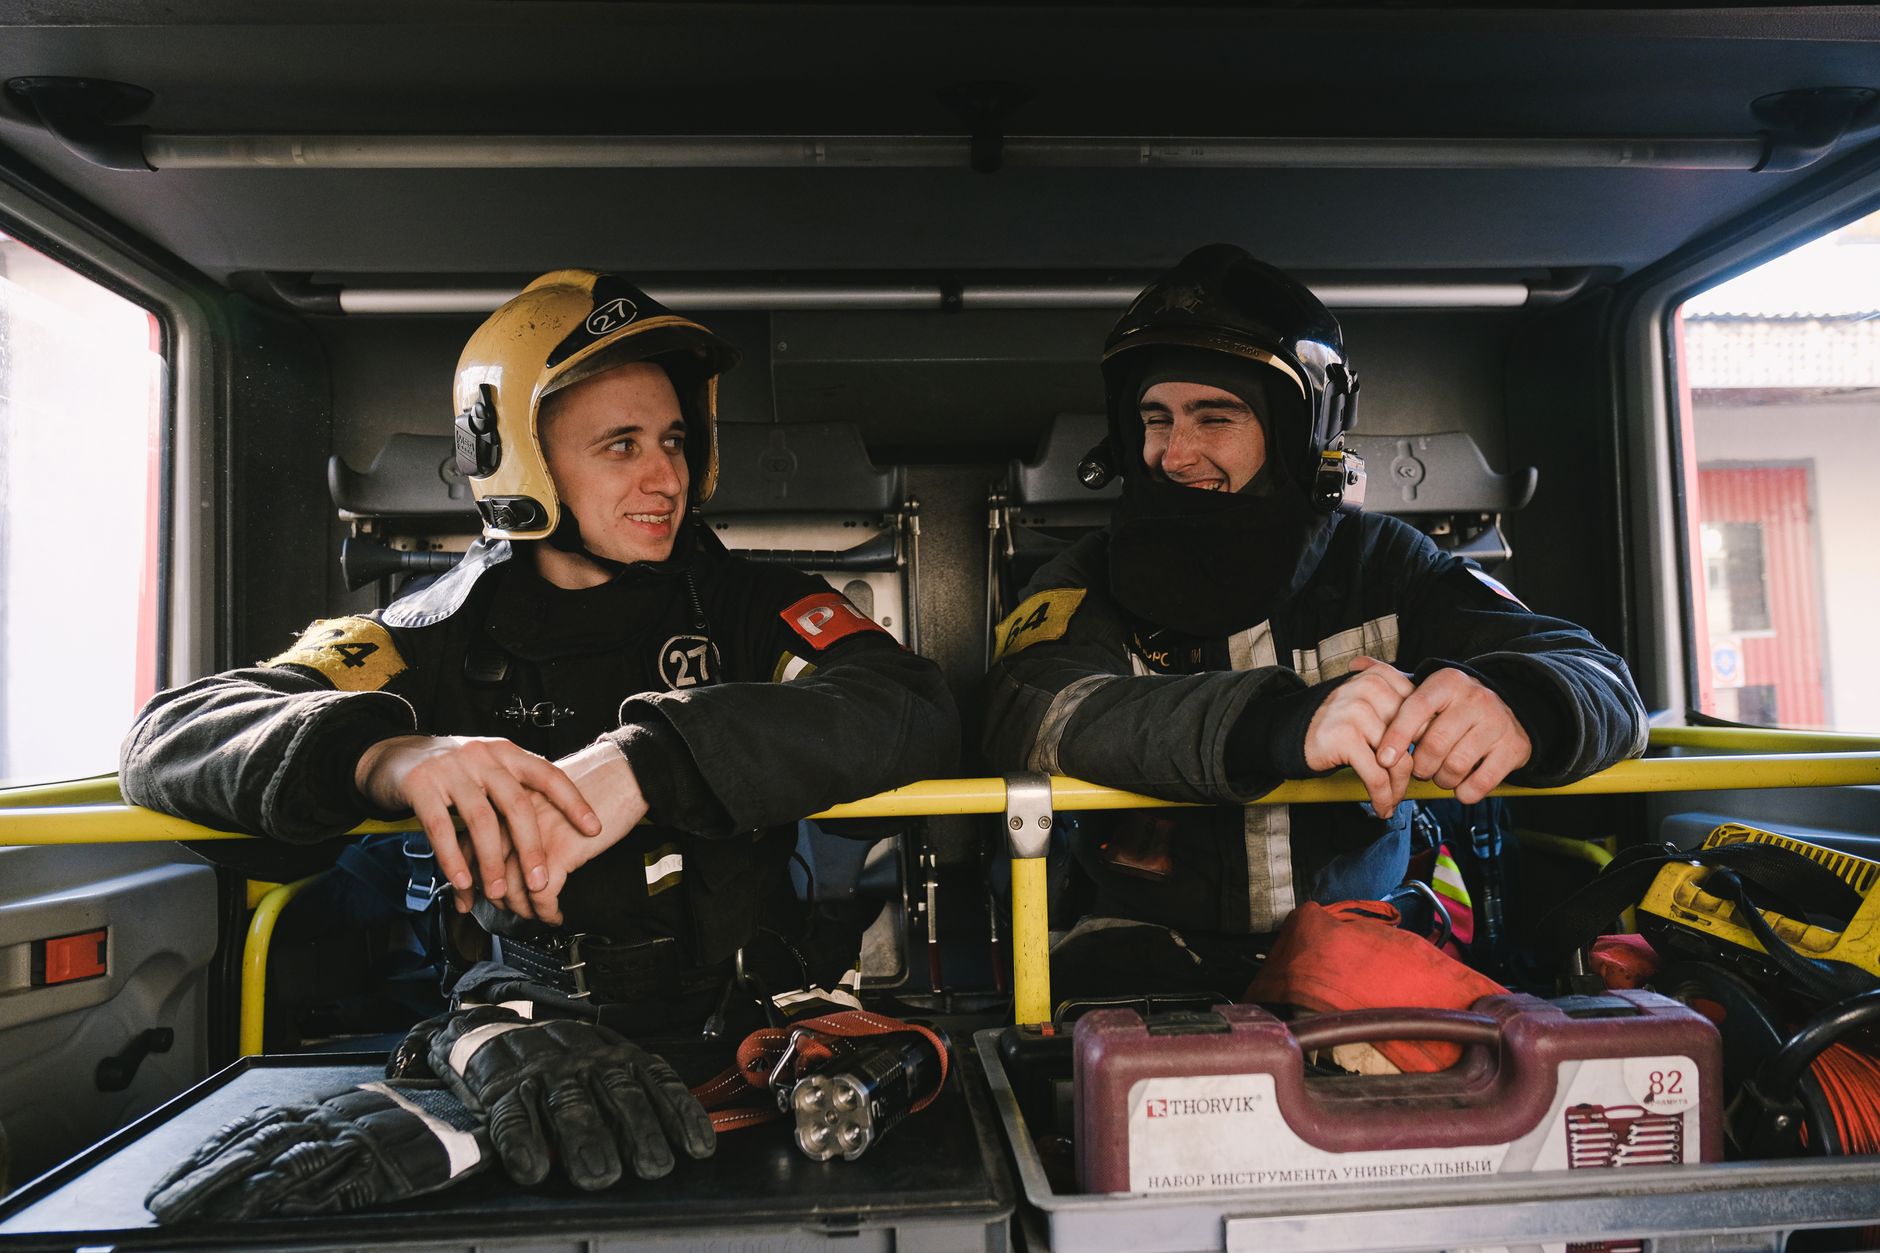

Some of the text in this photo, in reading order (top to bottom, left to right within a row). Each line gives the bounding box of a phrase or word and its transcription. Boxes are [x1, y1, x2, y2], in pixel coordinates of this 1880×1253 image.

[592, 300, 626, 332] 27
[669, 643, 710, 687] 27
[1649, 1070, 1683, 1095] 82
[1169, 1096, 1255, 1116] THORVIK
[1149, 1159, 1492, 1188] НАБОР ИНСТРУМЕНТА УНИВЕРСАЛЬНЫЙ
